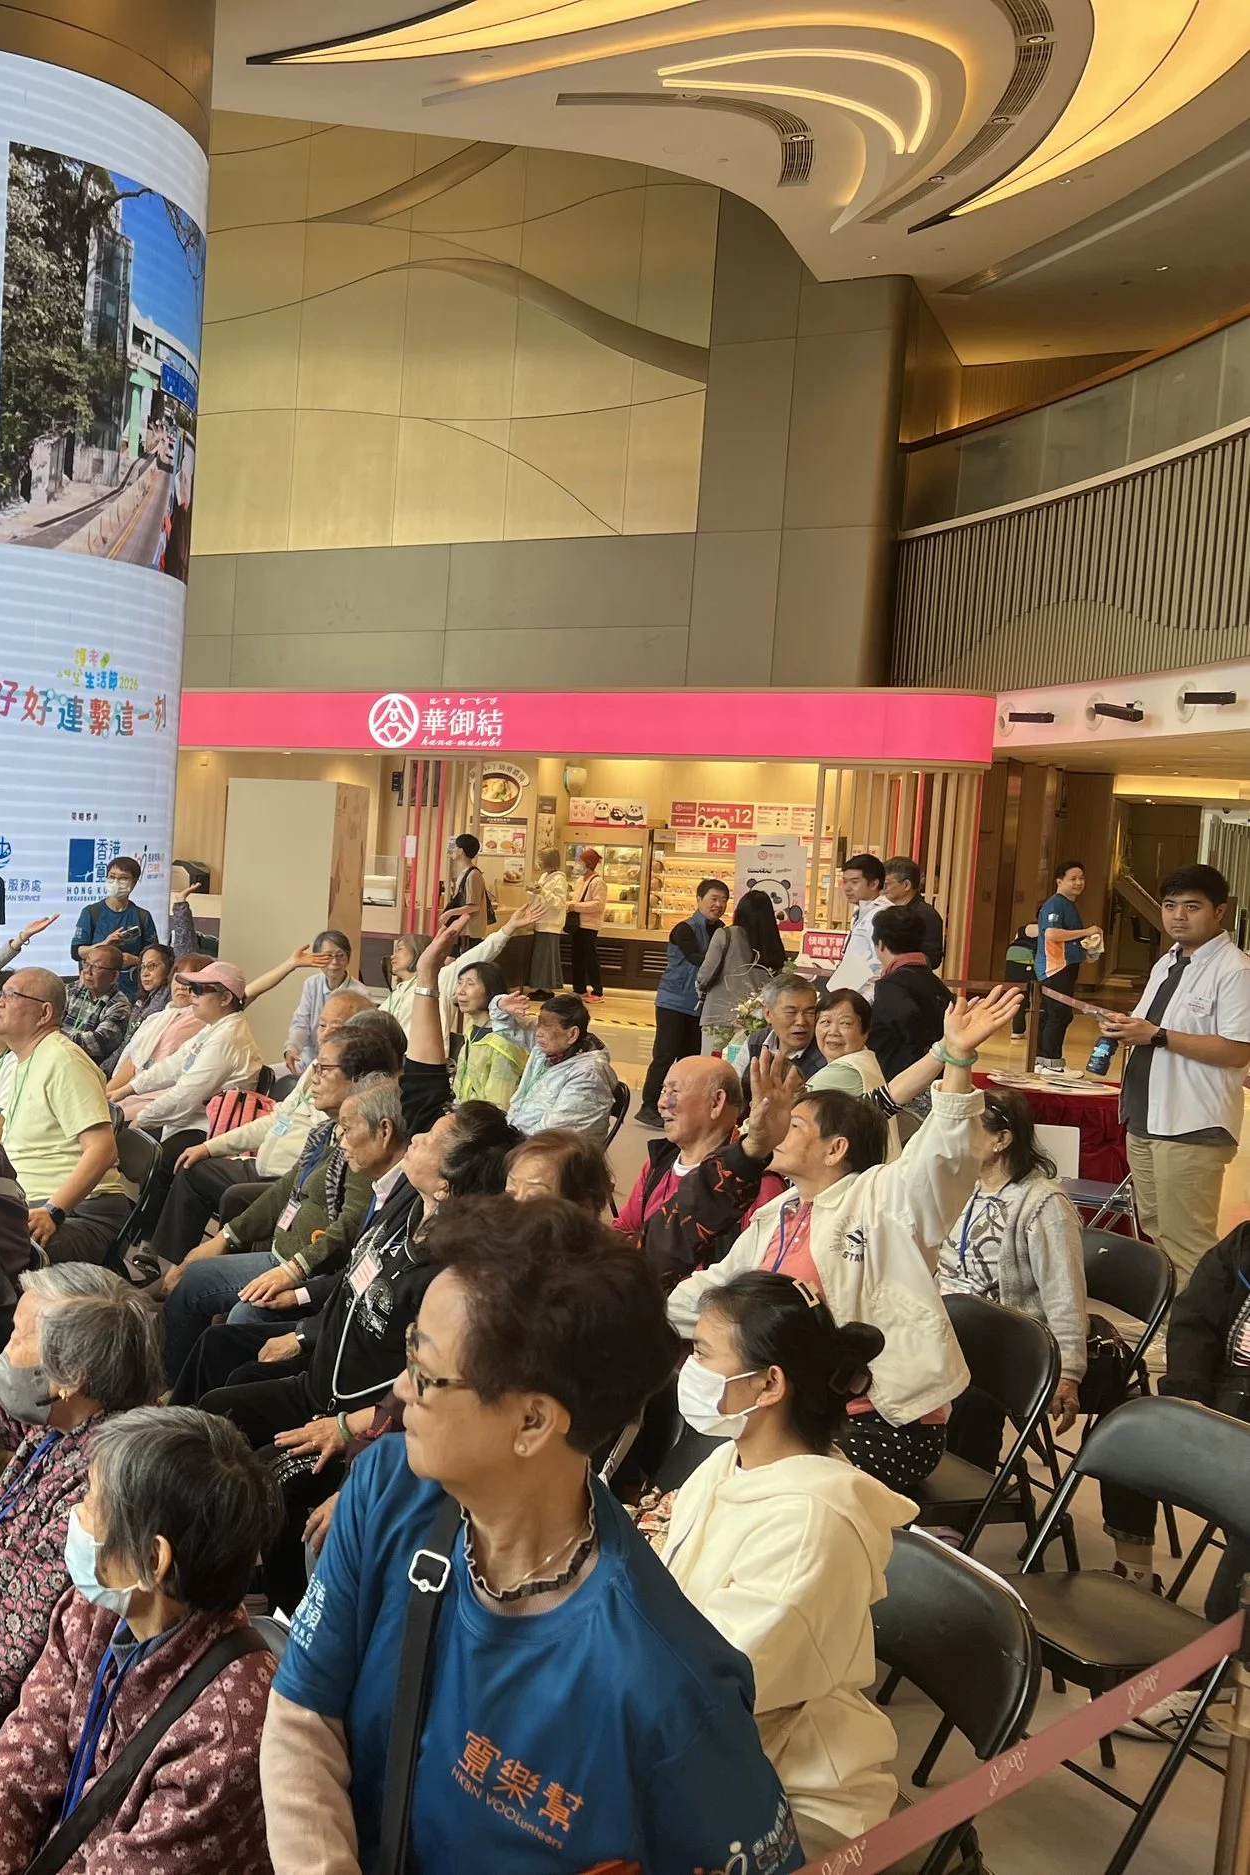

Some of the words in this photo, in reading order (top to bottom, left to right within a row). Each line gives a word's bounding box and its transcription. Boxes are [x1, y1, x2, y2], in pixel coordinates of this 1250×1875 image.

[421, 708, 503, 736] 華御結
[66, 886, 93, 895] HONG
[451, 1765, 482, 1799] HKBN
